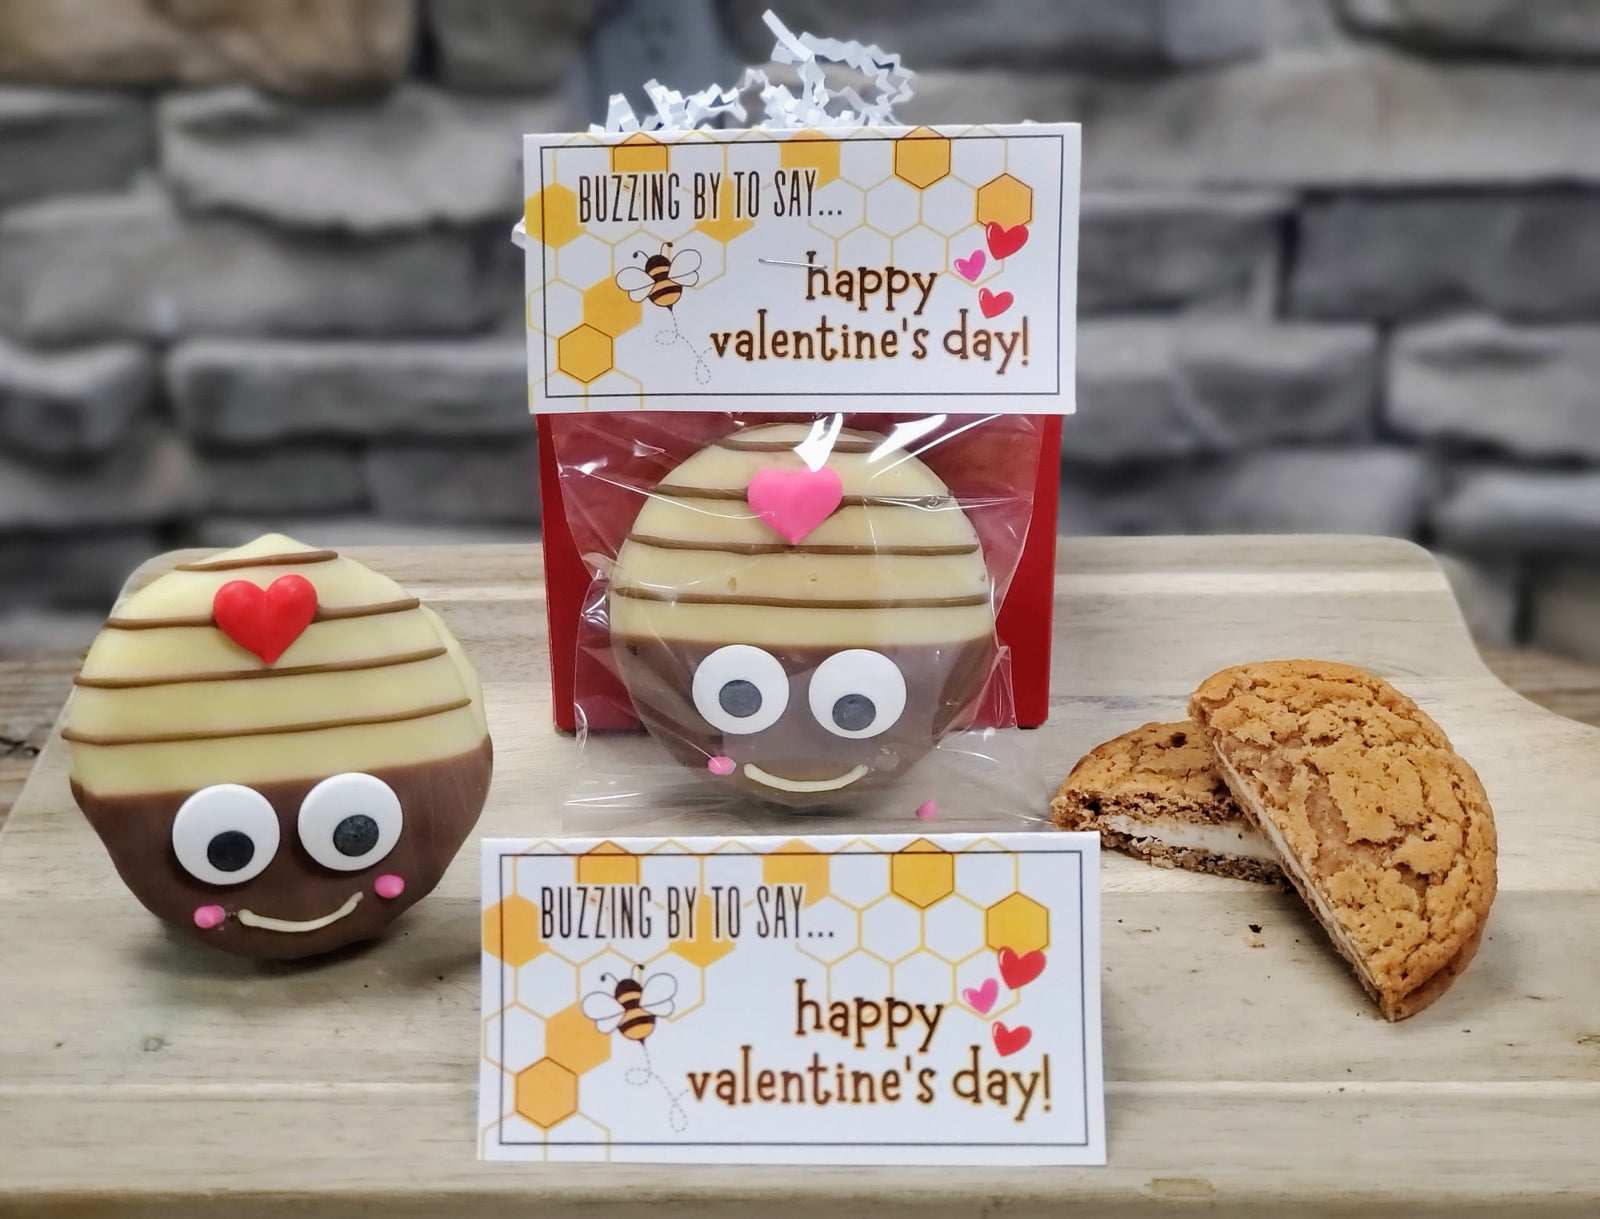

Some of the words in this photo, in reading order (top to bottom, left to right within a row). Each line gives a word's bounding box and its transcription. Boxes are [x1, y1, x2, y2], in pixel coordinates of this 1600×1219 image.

[578, 173, 681, 224] BUZZING
[694, 172, 723, 221] BY
[732, 171, 761, 219] TO
[774, 168, 843, 218] SAY...
[806, 251, 937, 314] happy
[710, 308, 929, 363] valentine's
[943, 308, 1031, 375] day!
[541, 886, 653, 940] BUZZING
[668, 886, 697, 940] BY
[712, 886, 741, 939] TO
[756, 884, 835, 940] SAY...
[796, 980, 944, 1052] happy
[687, 1045, 934, 1107] valentine's
[952, 1045, 1052, 1122] day!
